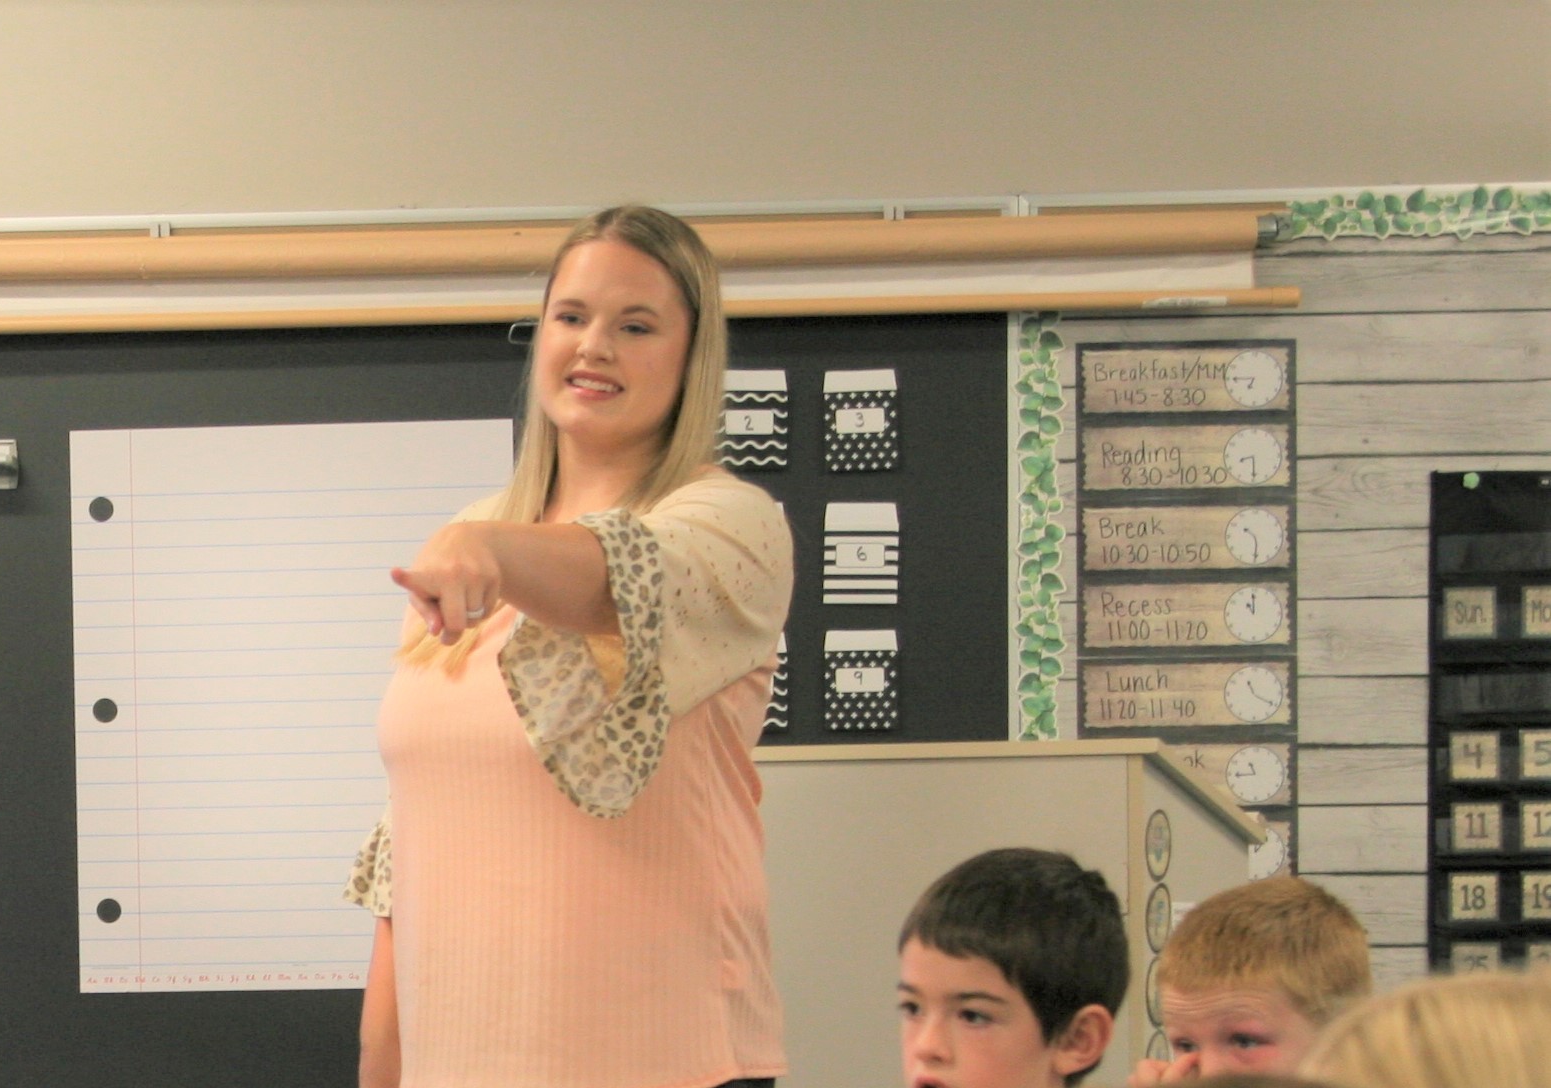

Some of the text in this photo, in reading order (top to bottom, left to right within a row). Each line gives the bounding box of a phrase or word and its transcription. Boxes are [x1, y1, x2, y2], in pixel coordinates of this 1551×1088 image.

[744, 415, 753, 431] 2
[854, 412, 864, 428] 3
[1101, 440, 1182, 474] Reading
[1099, 516, 1165, 540] Break
[856, 545, 867, 562] 6
[1101, 591, 1172, 617] Recess
[853, 669, 863, 685] 9
[1106, 669, 1168, 693] Lunch
[1463, 743, 1483, 770] 4
[1465, 812, 1489, 839] 11
[1460, 884, 1486, 911] 18
